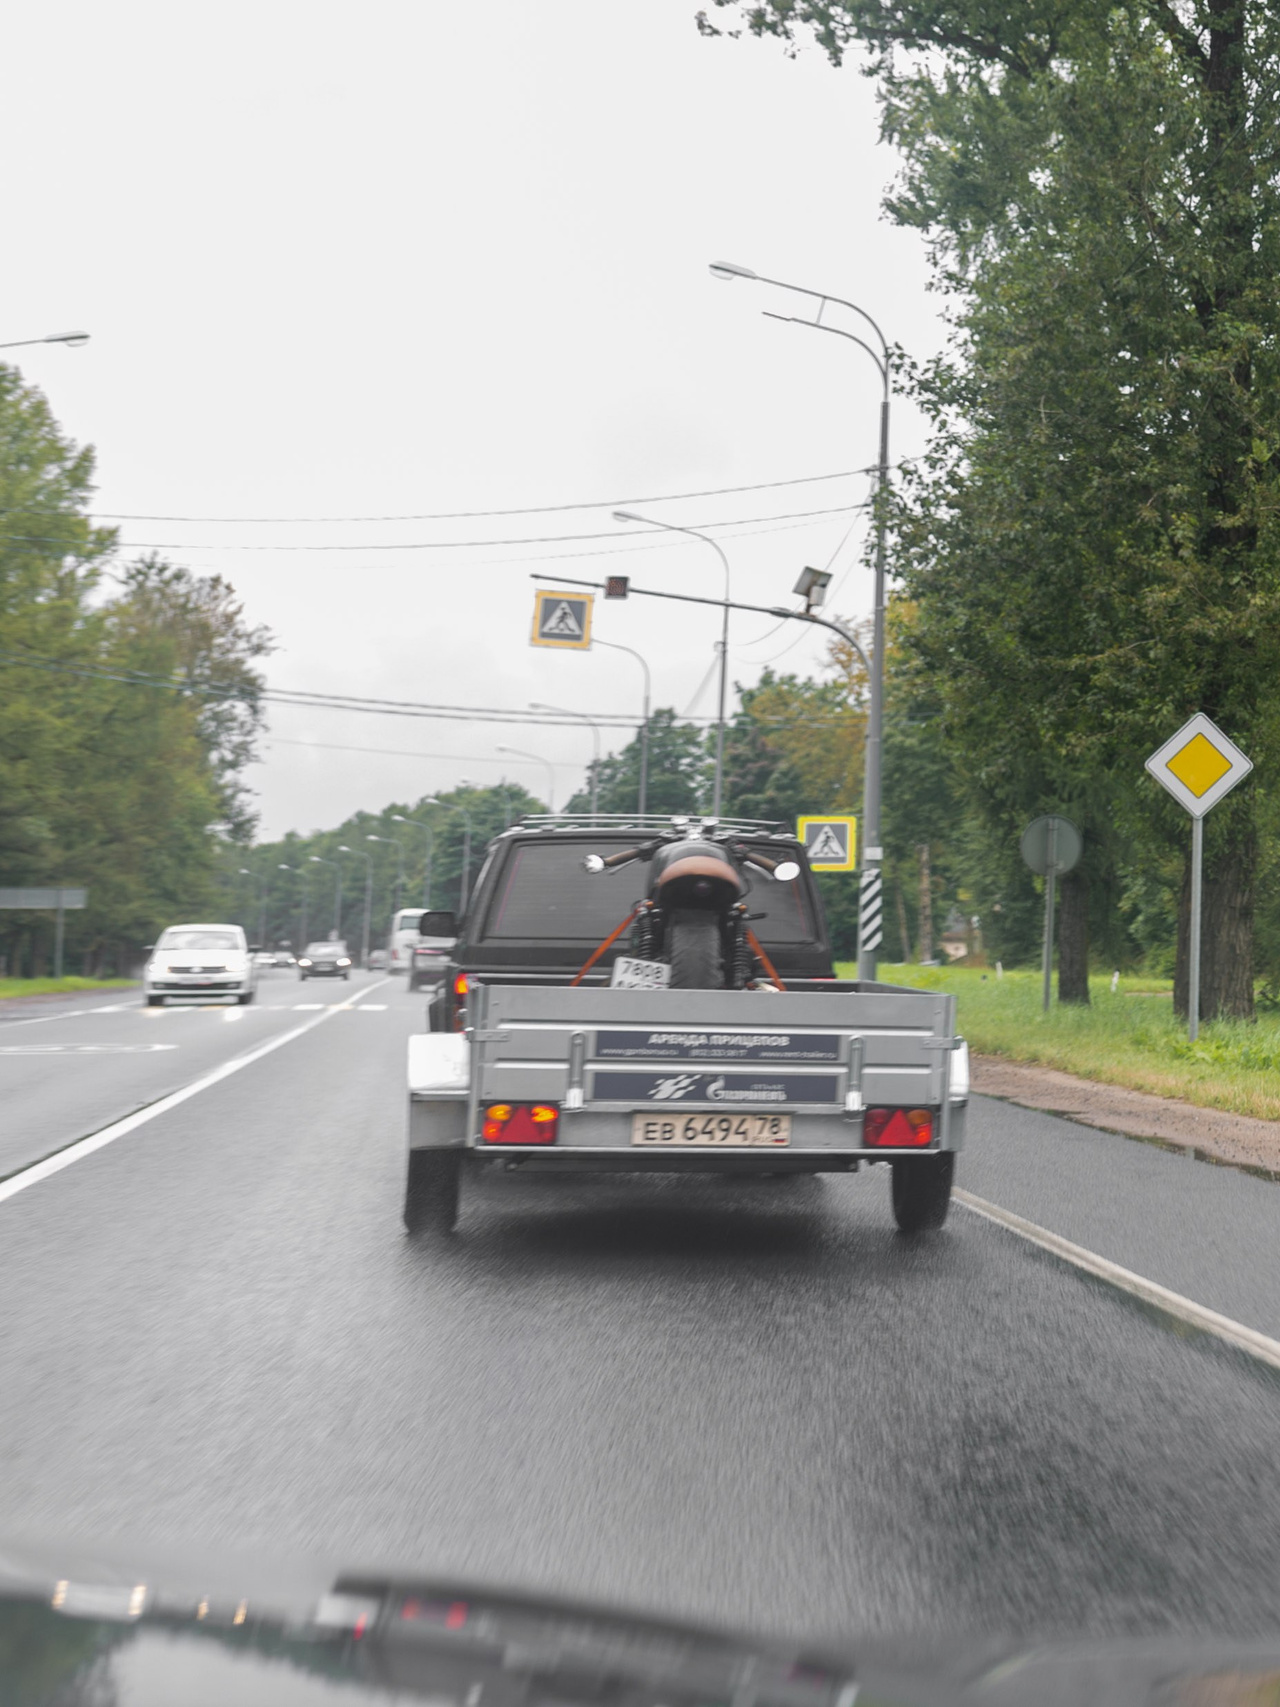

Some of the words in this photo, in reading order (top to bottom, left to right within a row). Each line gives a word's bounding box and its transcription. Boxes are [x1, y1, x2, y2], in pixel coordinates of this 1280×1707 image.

[648, 1033, 708, 1047] АРЕНДА
[709, 1034, 791, 1048] ПРИЦЕПОВ
[683, 1116, 749, 1141] 6494
[755, 1116, 782, 1135] 78
